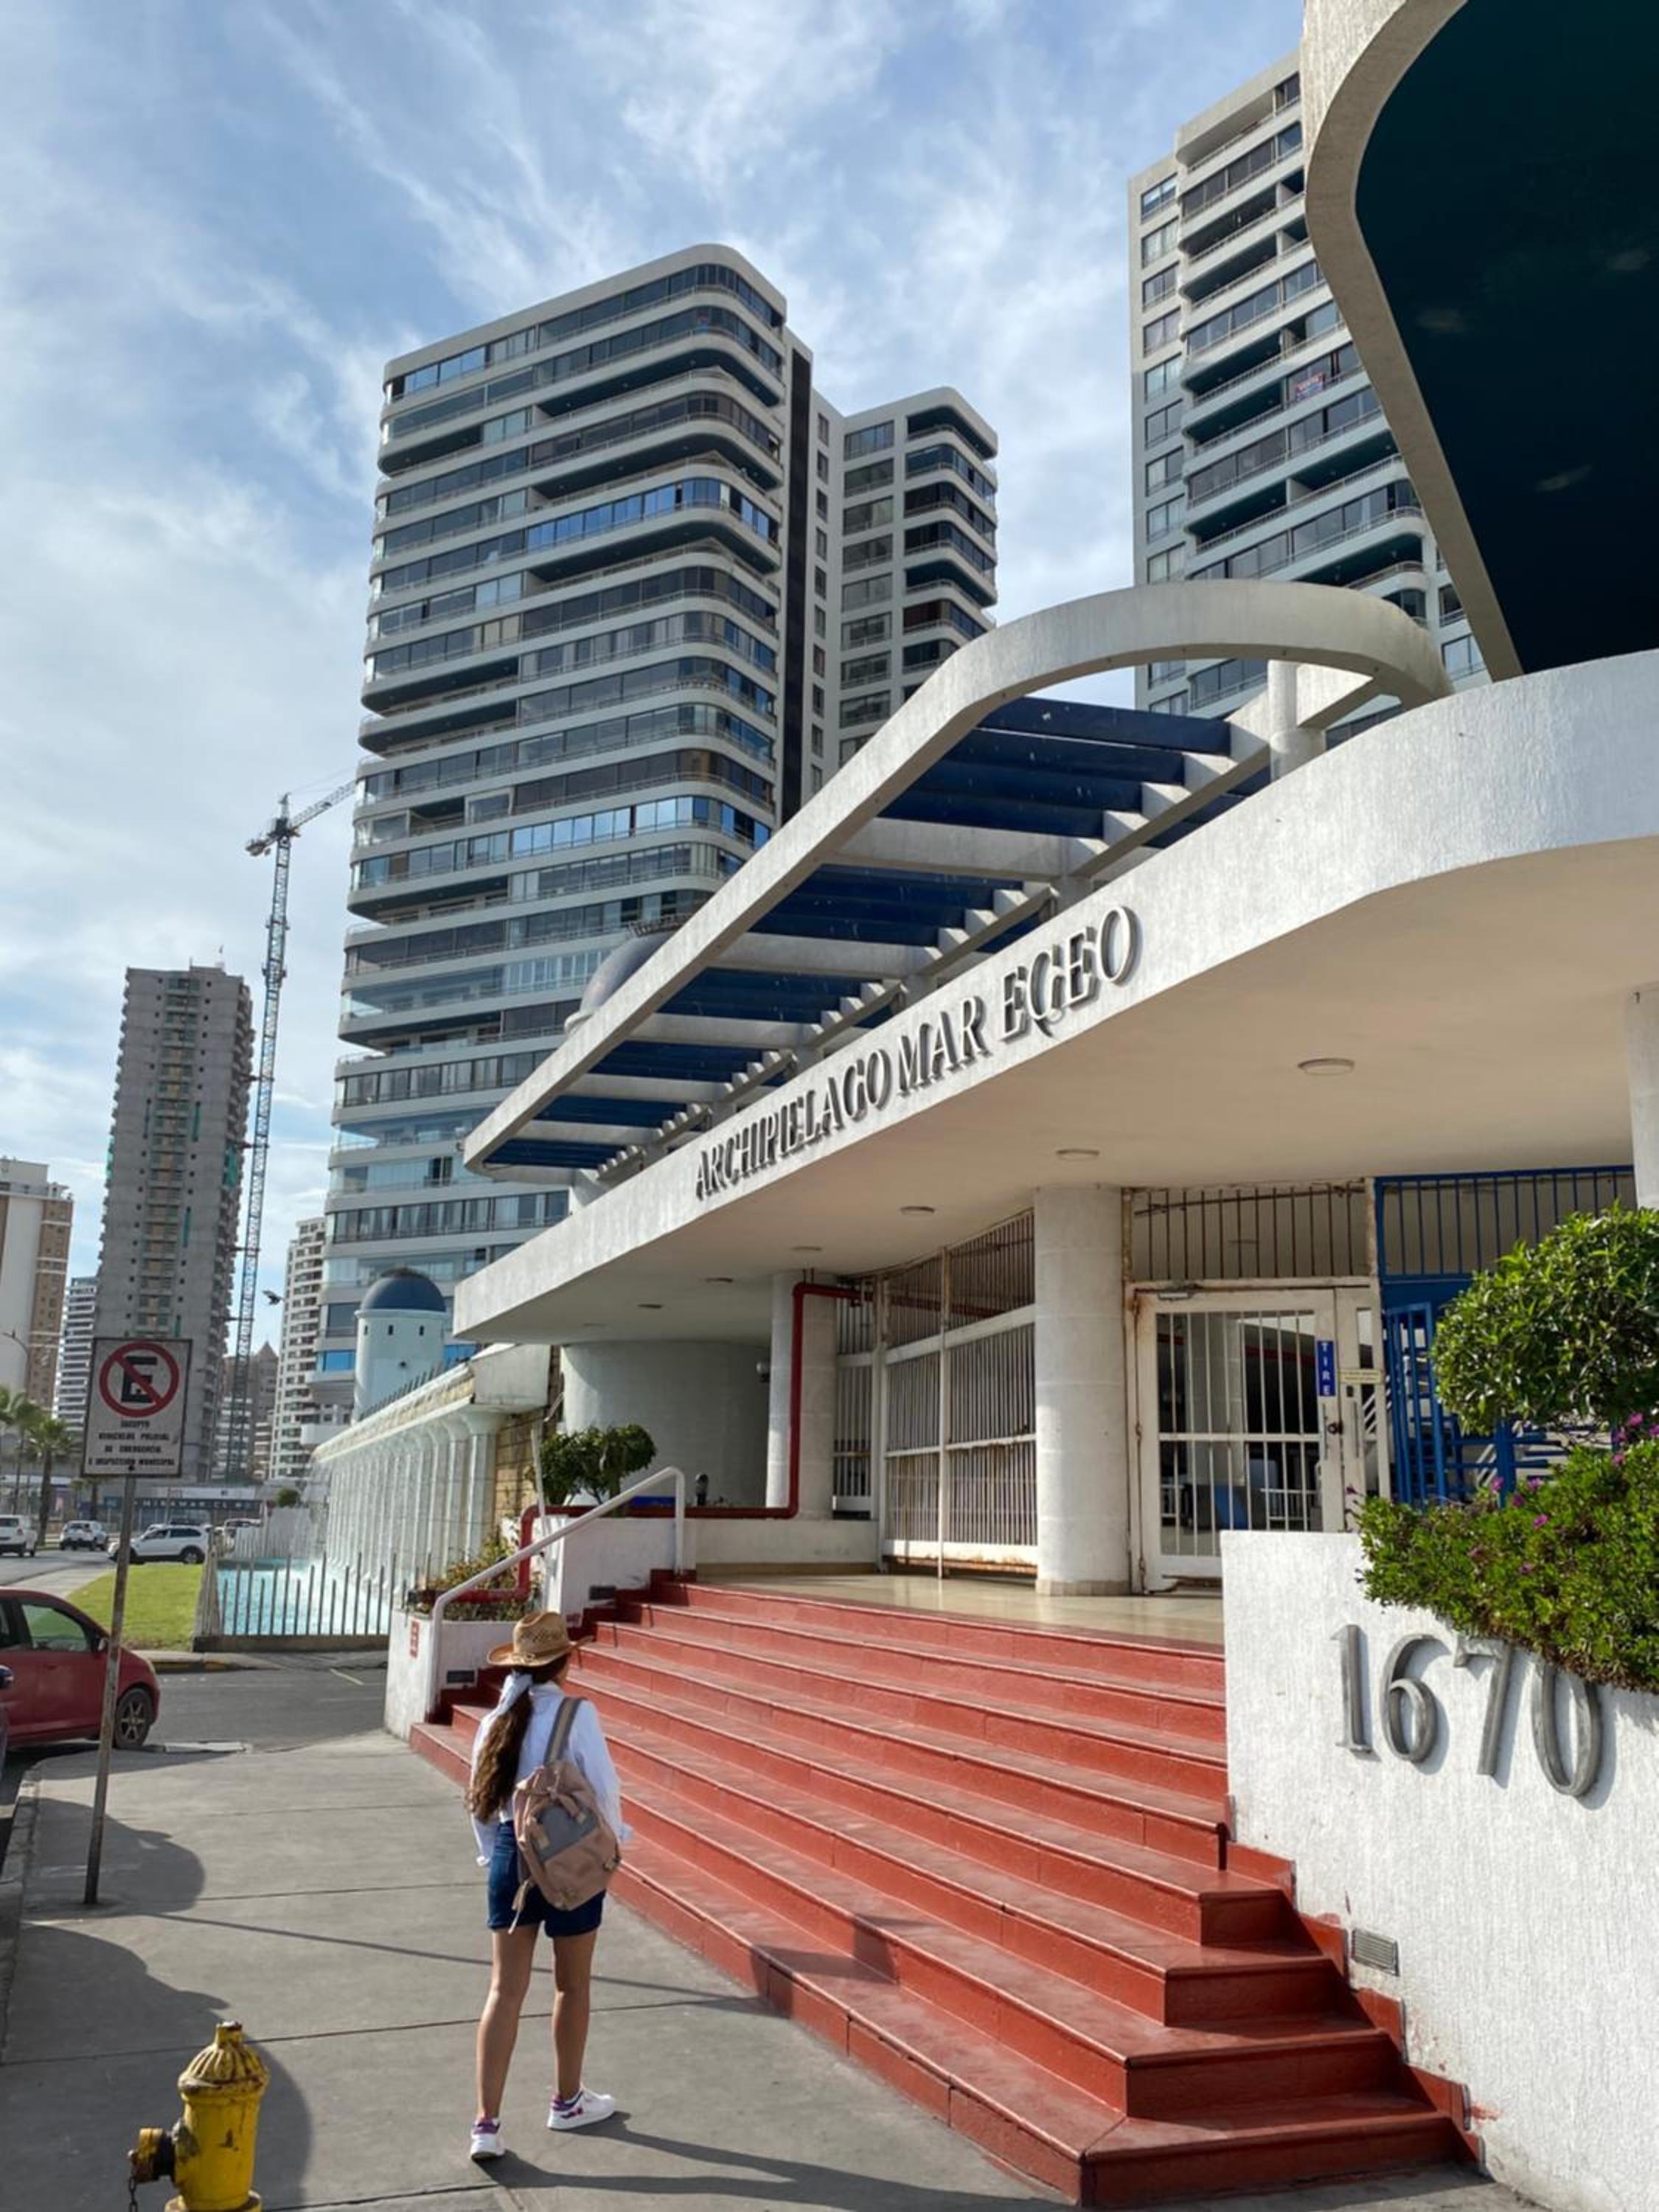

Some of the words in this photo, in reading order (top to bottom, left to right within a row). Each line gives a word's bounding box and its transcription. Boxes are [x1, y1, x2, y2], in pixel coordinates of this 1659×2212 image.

[695, 1048, 893, 1200] ARCHIPIELAGO
[897, 995, 992, 1099] MAR
[998, 906, 1141, 1044] EGEO
[1321, 1343, 1330, 1395] TIRE
[1331, 1624, 1603, 1797] 1670
